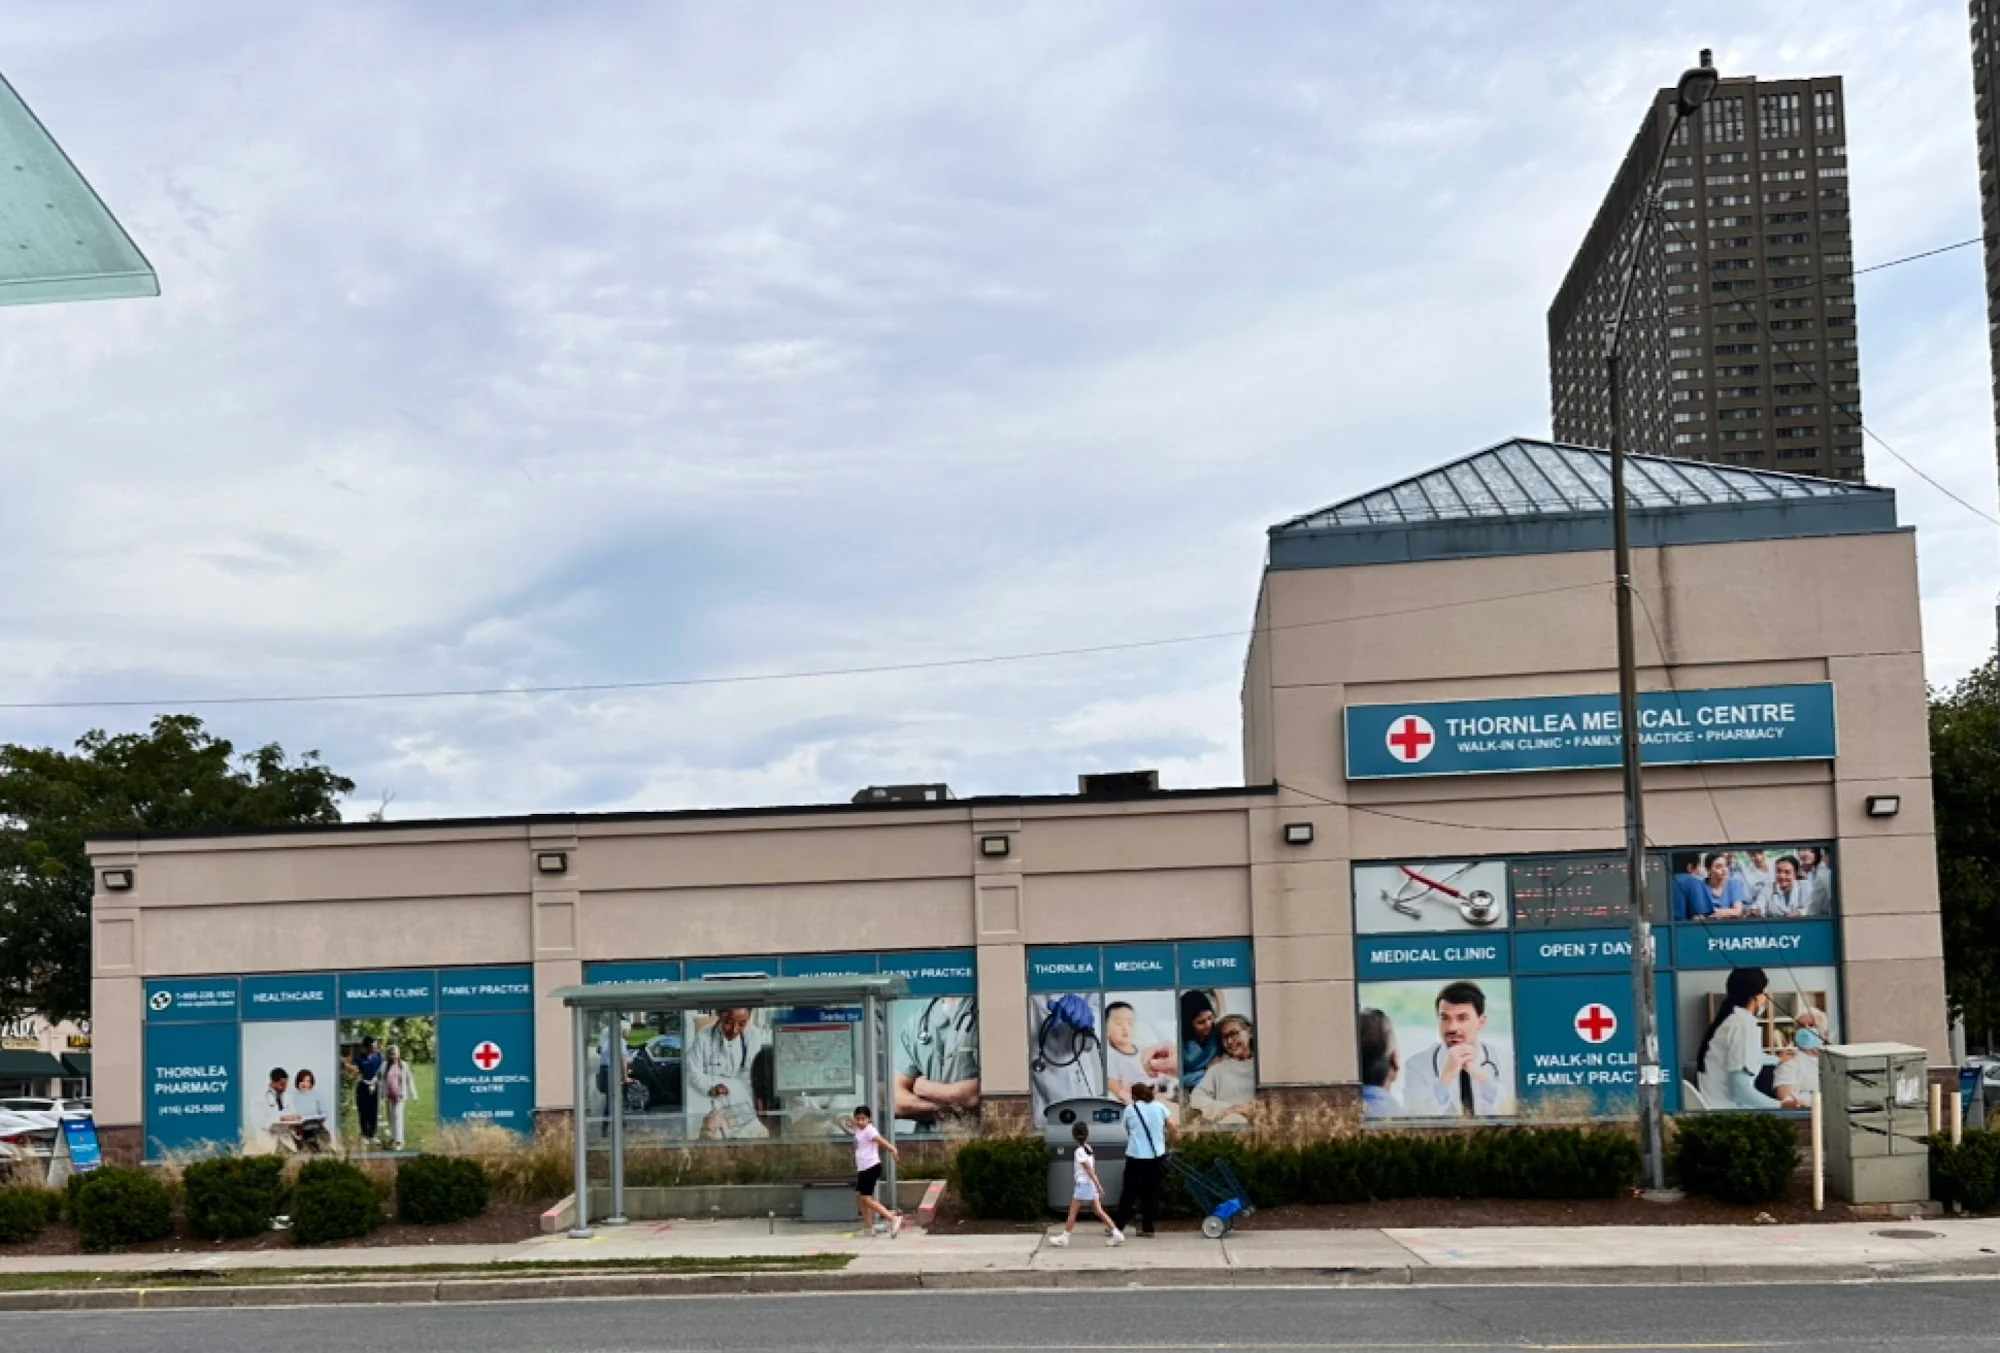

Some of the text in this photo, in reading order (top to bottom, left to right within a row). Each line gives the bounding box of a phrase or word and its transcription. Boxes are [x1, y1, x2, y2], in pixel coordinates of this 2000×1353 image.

[1444, 703, 1796, 737] THORNLEA MEICAL CENTRE
[1457, 727, 1785, 752] WALK-IN CLINIC FAMILY RACTICE PHARMACY
[1539, 941, 1633, 957] OPEN 7 DAY
[1707, 935, 1801, 951] PHARMACY
[1370, 946, 1496, 963] MEDICAL CLINIC
[1035, 962, 1094, 974] THORNLEA
[1114, 961, 1163, 972] MEDICAL
[1192, 957, 1237, 969] CENTRE
[921, 967, 974, 978] PRACTICE
[346, 986, 429, 999] WALK-IN CLINIC
[442, 984, 530, 996] FAMILY PRACTICE
[253, 991, 324, 1003] HEALTHCARE
[1533, 1053, 1602, 1067] WALK-IN
[156, 1065, 228, 1079] THORNLEA
[1527, 1072, 1584, 1085] FAMILY
[154, 1080, 229, 1095] PHARMACY
[469, 1083, 504, 1093] CENTRE
